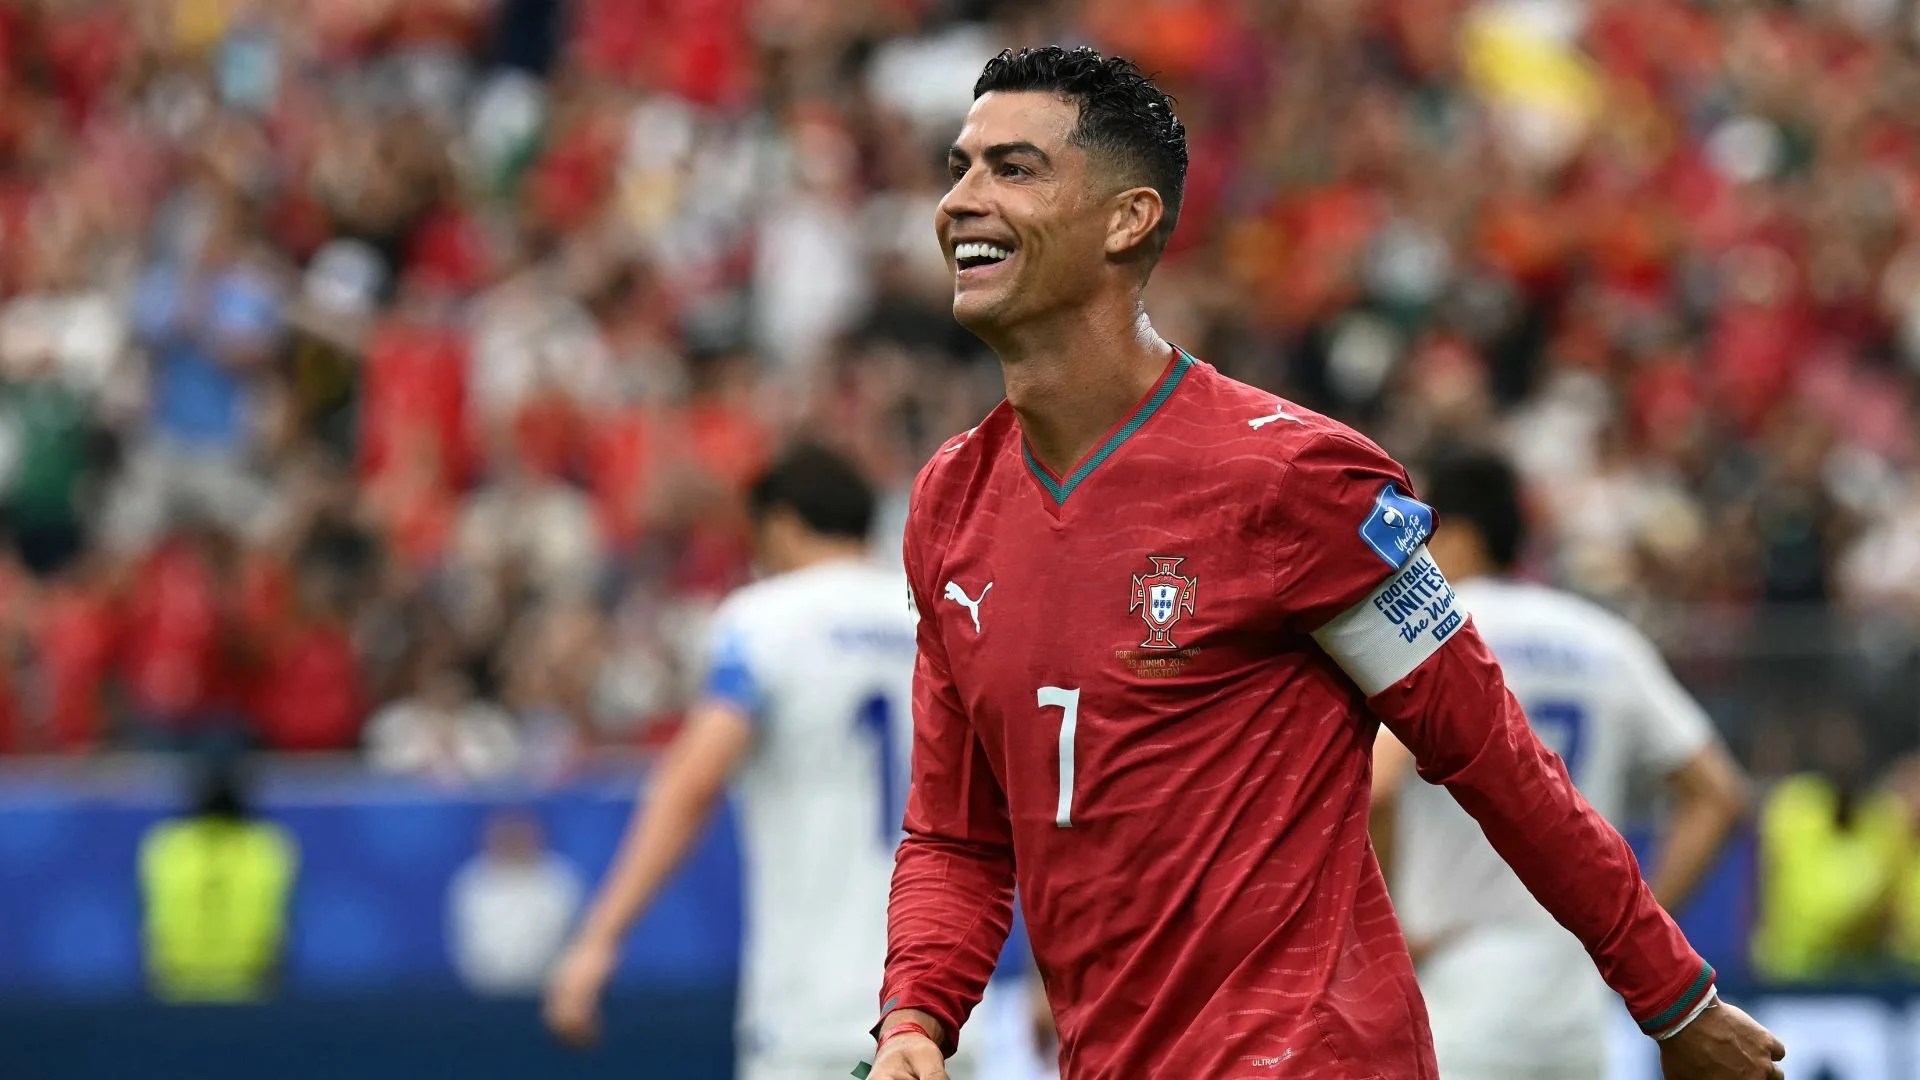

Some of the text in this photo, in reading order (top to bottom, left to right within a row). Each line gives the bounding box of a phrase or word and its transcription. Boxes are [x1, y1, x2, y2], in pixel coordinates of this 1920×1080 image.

[1373, 557, 1432, 611] FOOTBALL
[1382, 567, 1445, 625] UNITES
[1399, 618, 1429, 644] the
[1435, 612, 1461, 638] FIFA
[1127, 658, 1189, 669] 23 JUNHO 202
[1137, 667, 1180, 679] HOUSTON
[1037, 686, 1081, 828] 7
